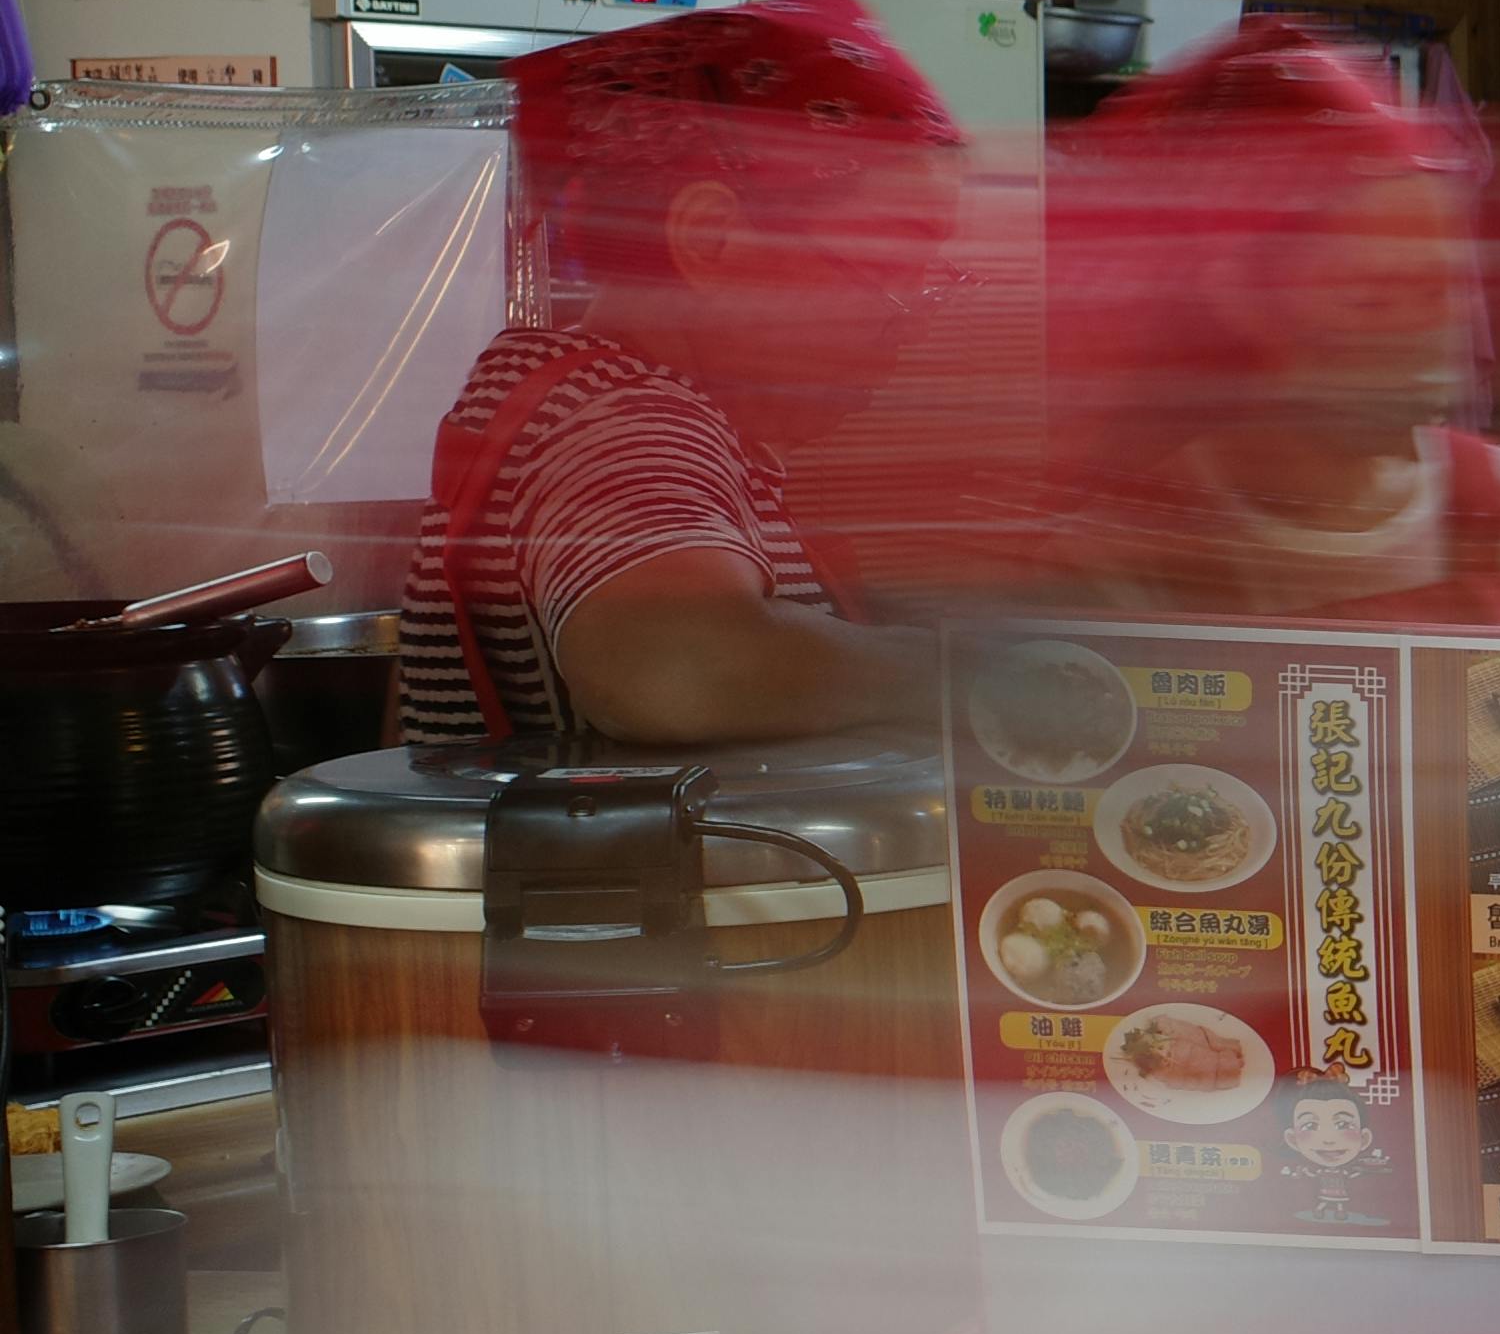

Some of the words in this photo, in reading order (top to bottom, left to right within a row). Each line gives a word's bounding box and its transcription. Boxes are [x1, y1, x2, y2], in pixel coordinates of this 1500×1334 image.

[1151, 670, 1227, 697] 魯肉飯
[1307, 698, 1374, 1068] 張記九份傳統魚丸
[1149, 910, 1271, 937] 綜合魚丸湯
